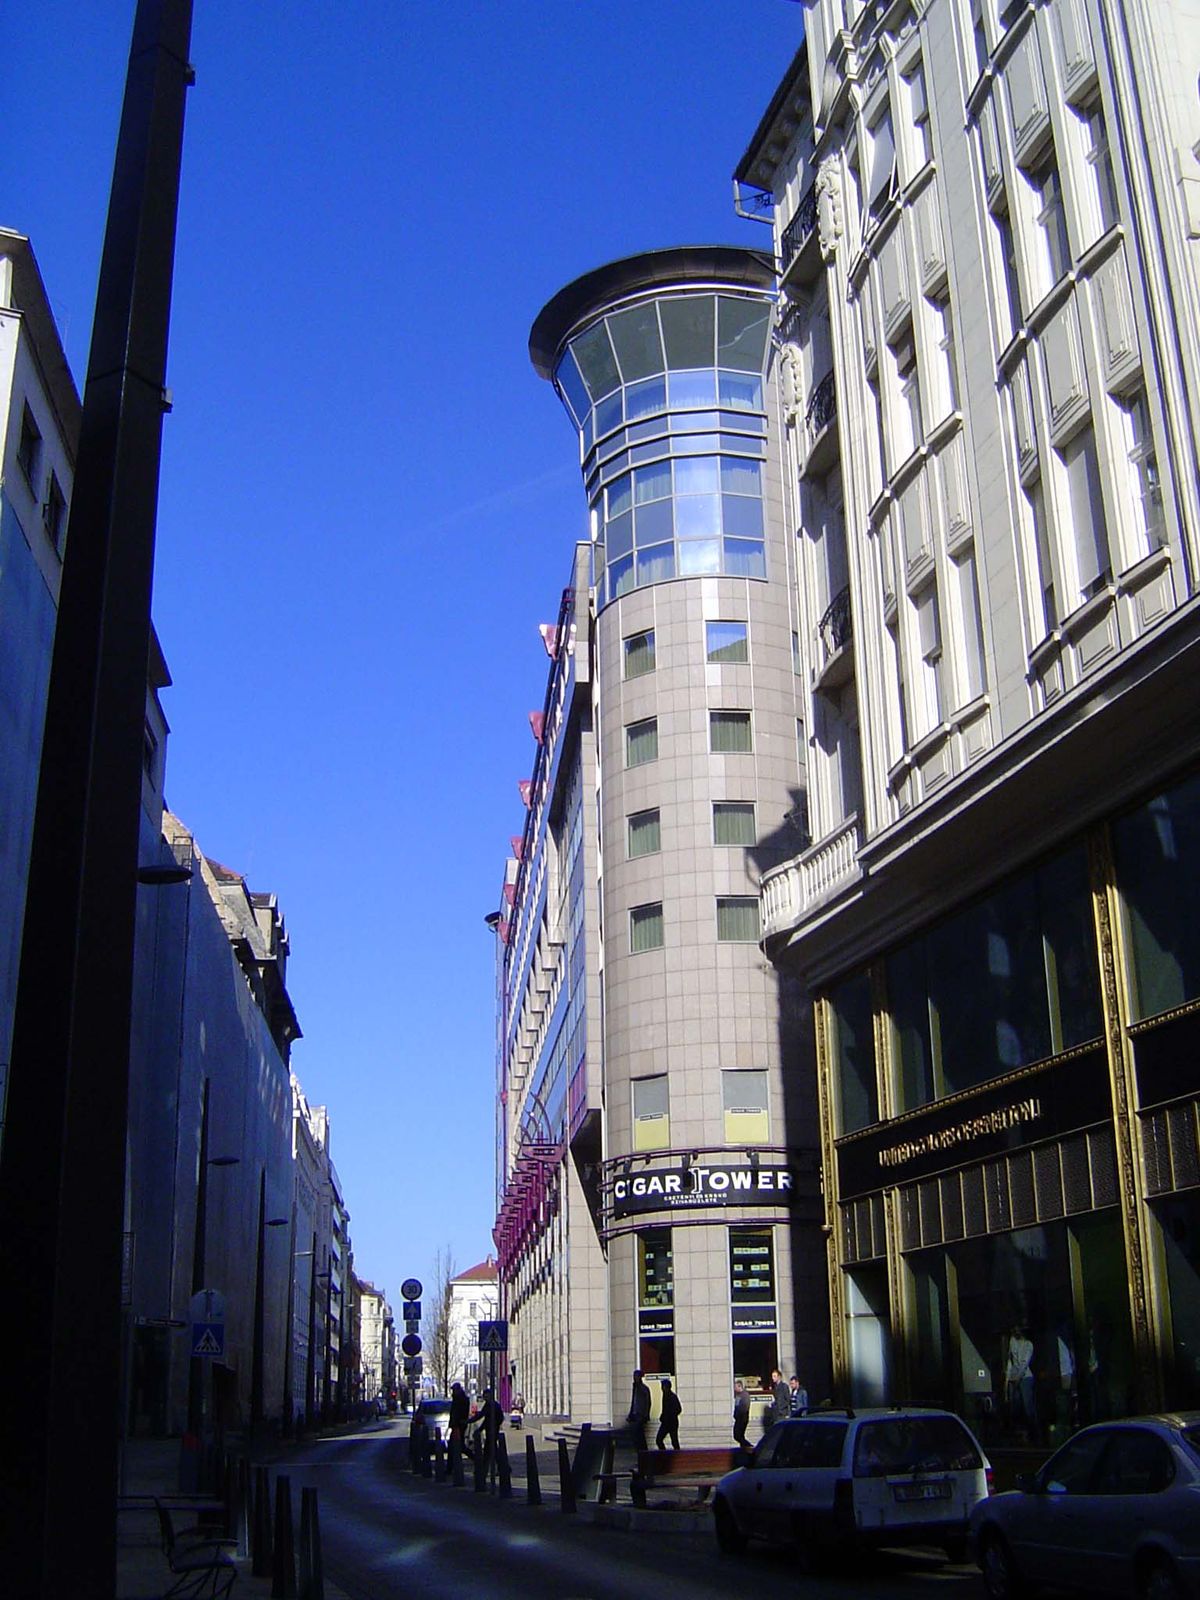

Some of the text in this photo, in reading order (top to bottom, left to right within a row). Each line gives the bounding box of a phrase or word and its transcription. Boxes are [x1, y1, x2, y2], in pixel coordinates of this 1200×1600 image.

[614, 1167, 792, 1198] CIGAR TOWER
[406, 1285, 418, 1294] 30
